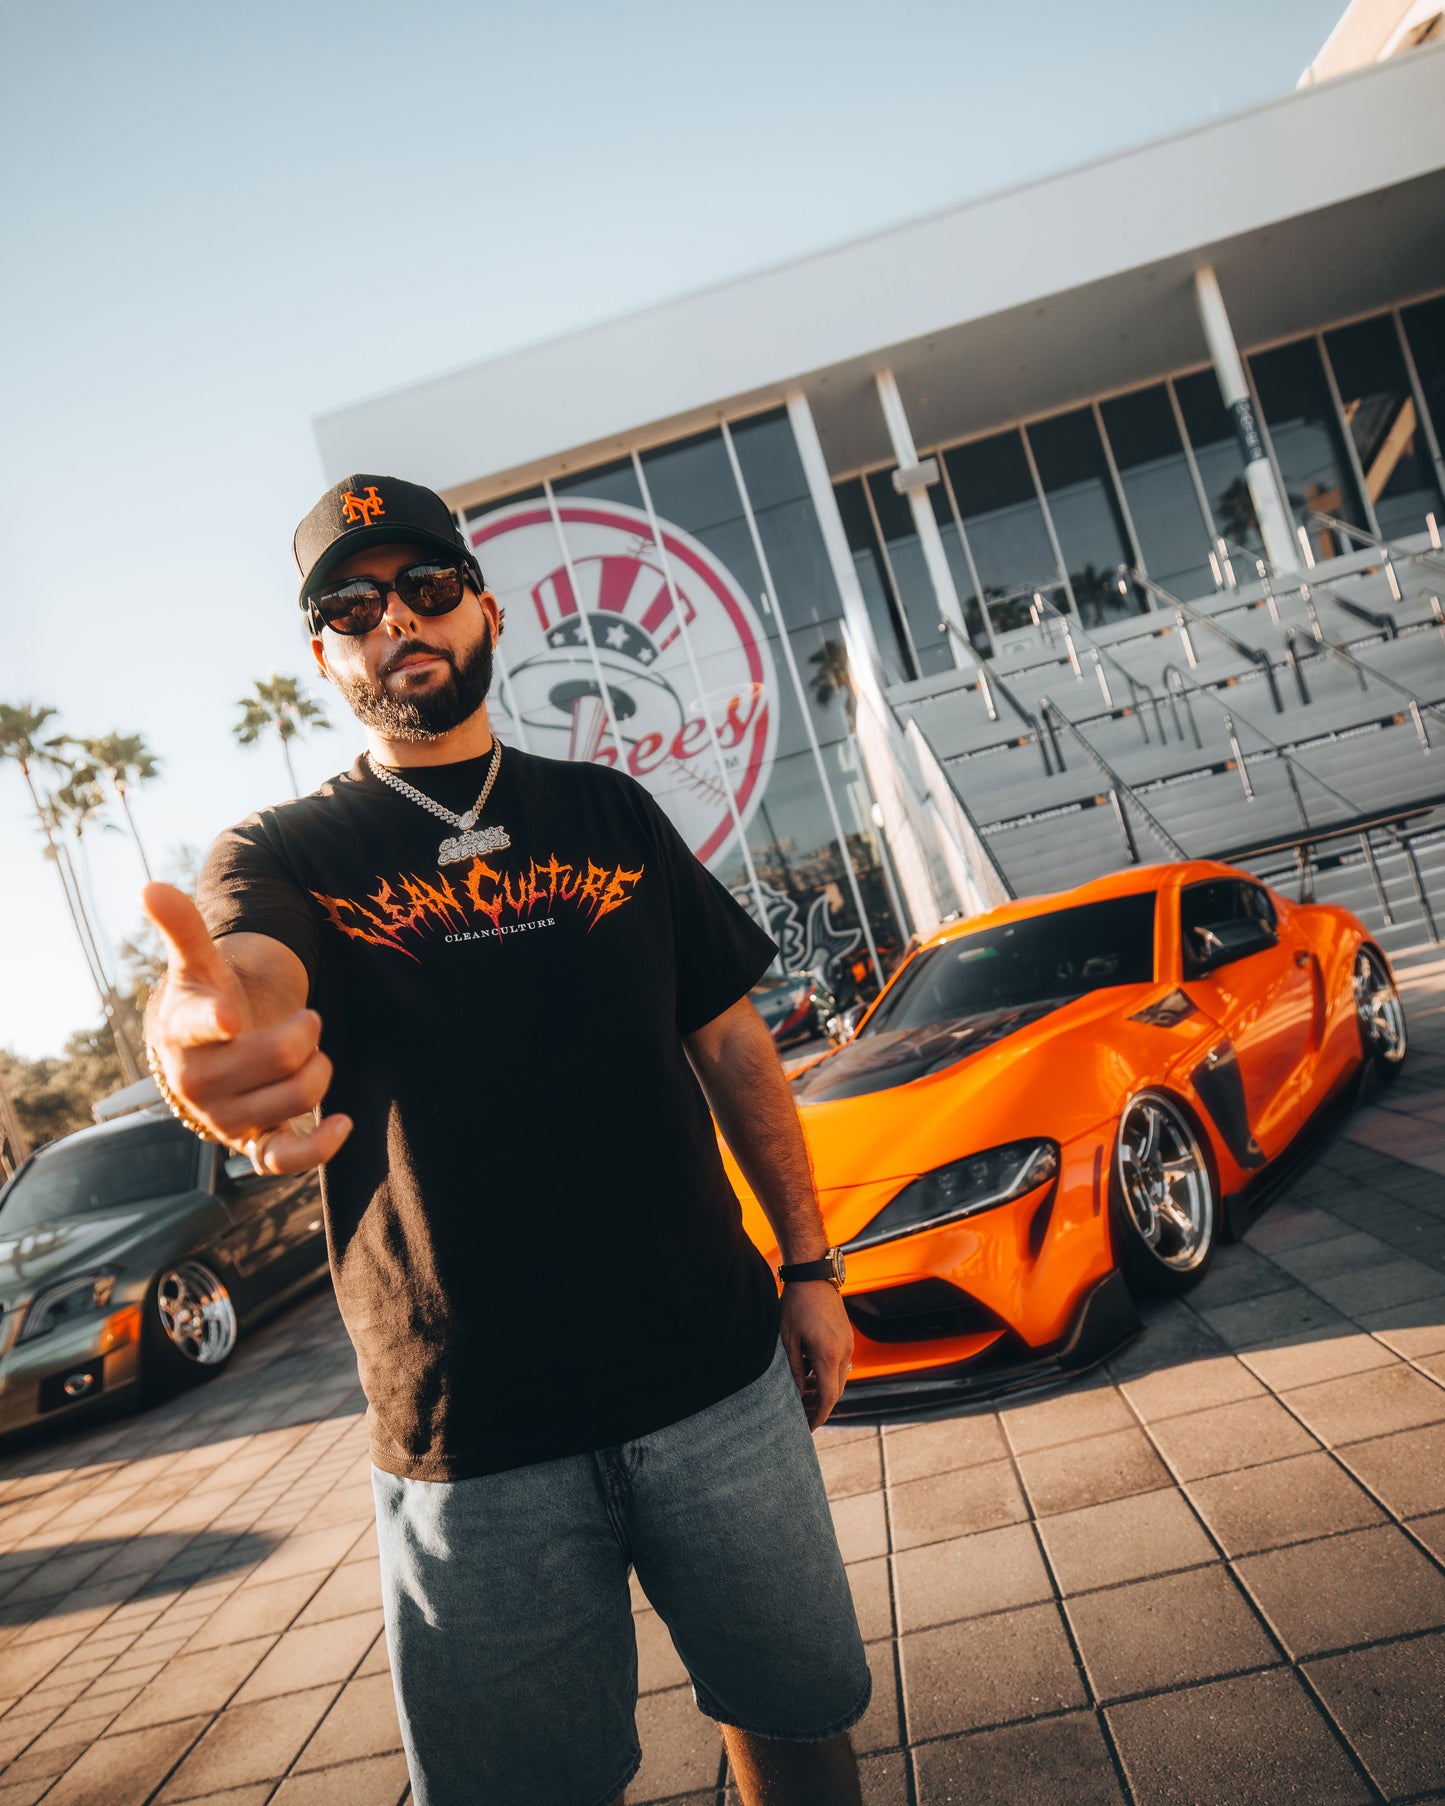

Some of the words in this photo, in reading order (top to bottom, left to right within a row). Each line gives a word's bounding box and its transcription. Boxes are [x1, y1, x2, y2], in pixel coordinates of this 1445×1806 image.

[308, 868, 470, 965] CLEAN
[460, 852, 645, 945] CULTURE
[443, 917, 557, 943] CLEANCULTURE
